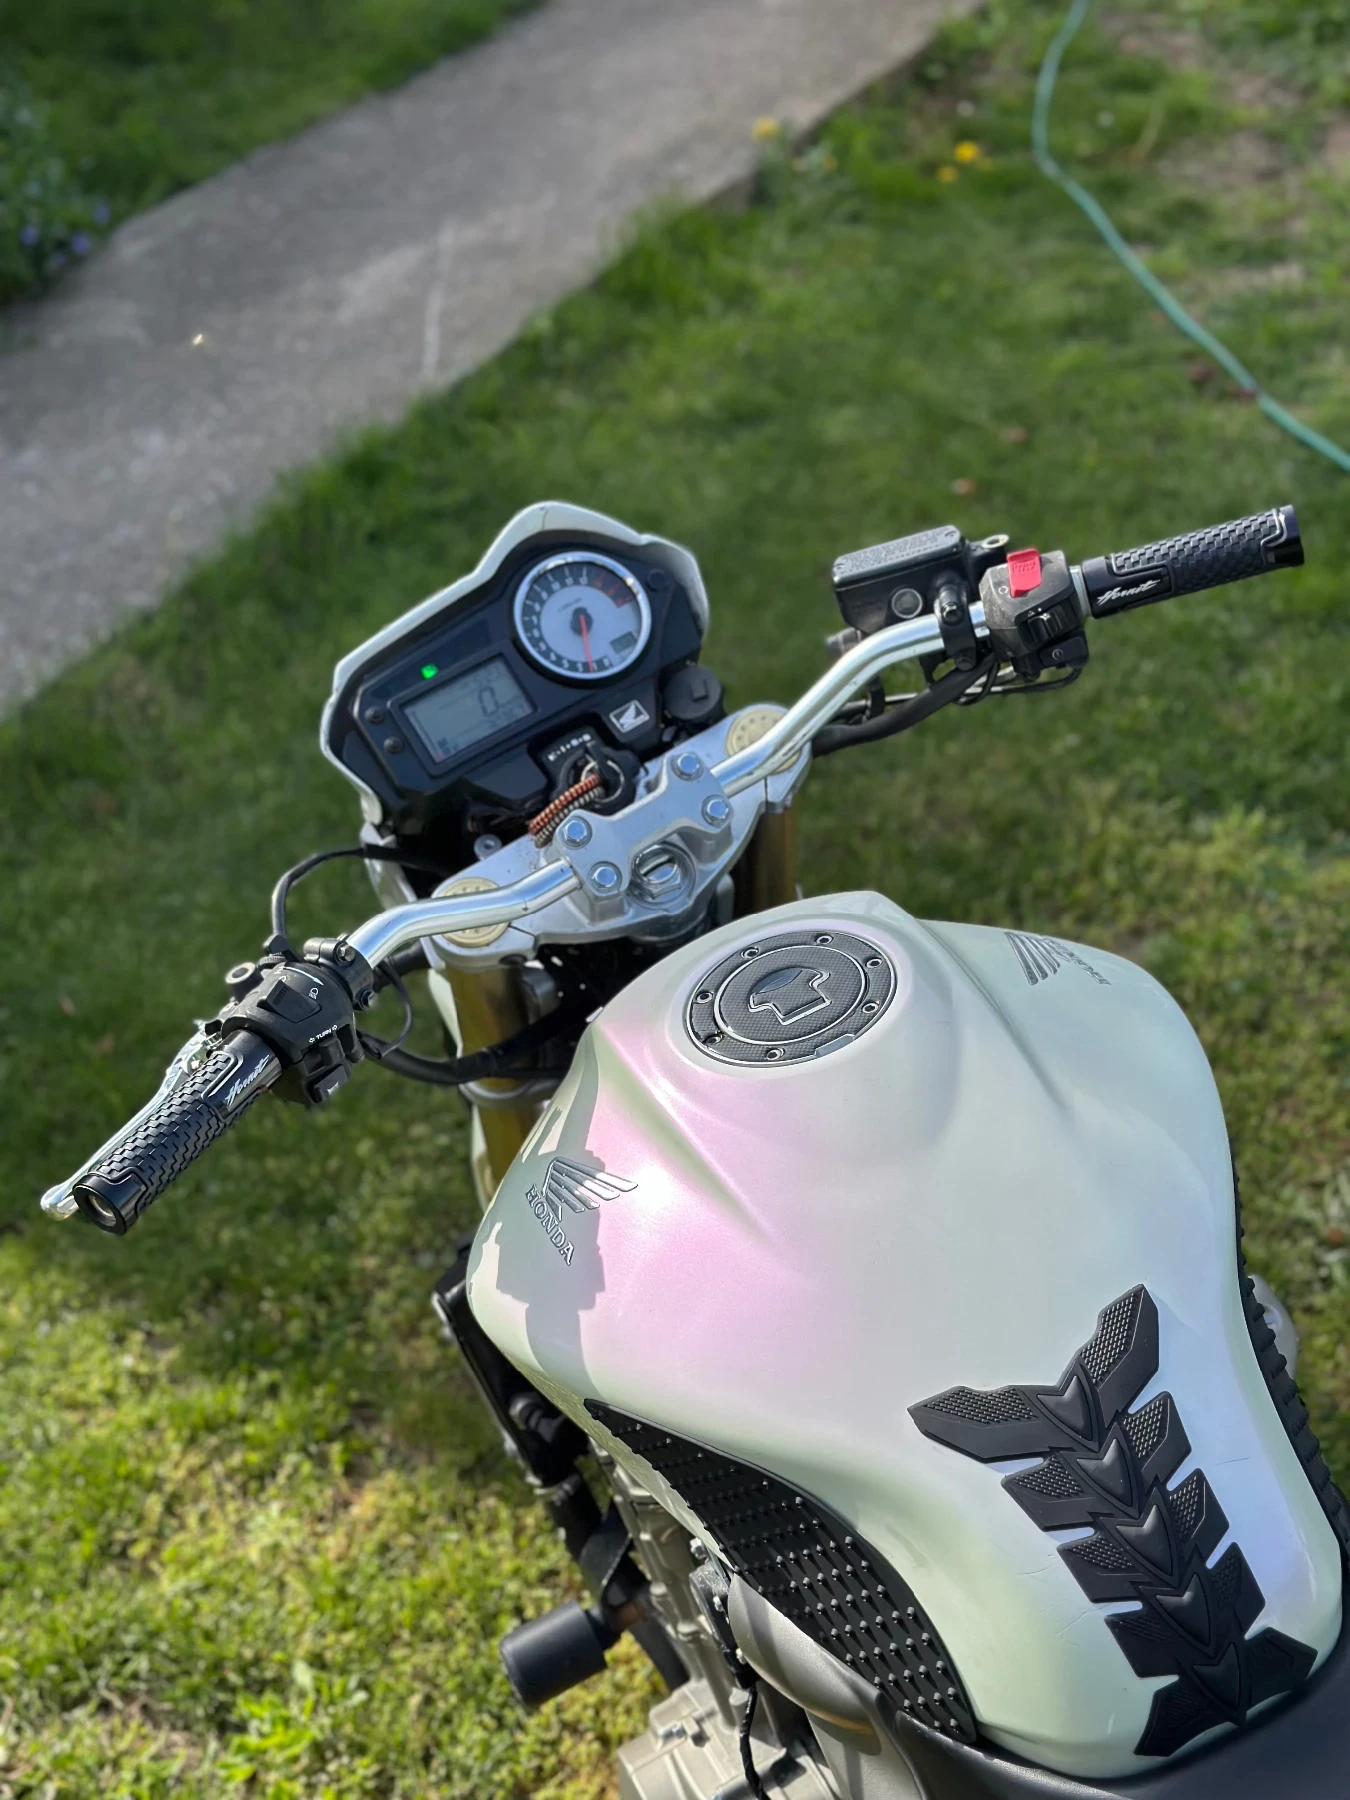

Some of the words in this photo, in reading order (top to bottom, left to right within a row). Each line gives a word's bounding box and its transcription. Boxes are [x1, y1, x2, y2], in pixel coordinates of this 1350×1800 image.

[1097, 579, 1161, 606] Hornet
[479, 686, 498, 716] 0
[225, 1054, 270, 1107] Hornet
[525, 1184, 575, 1266] HONDA
